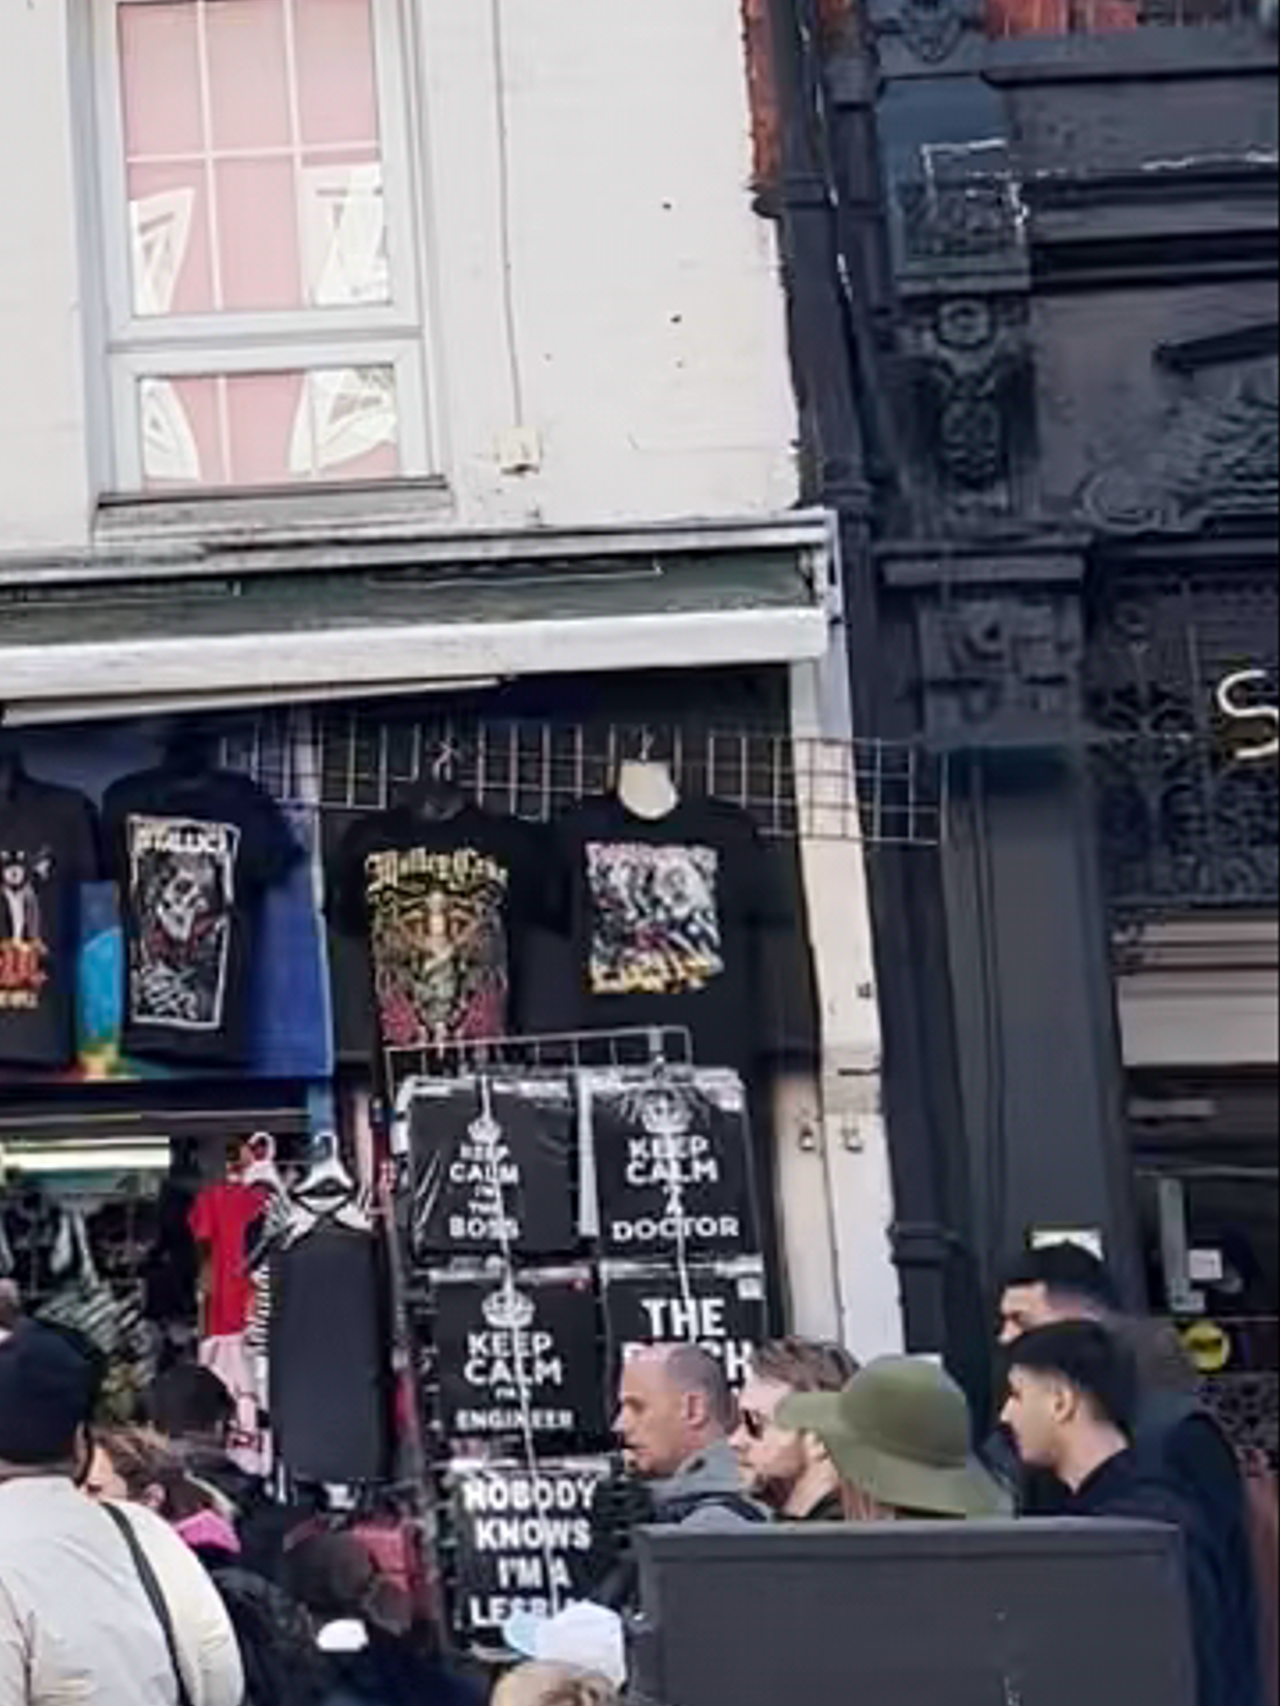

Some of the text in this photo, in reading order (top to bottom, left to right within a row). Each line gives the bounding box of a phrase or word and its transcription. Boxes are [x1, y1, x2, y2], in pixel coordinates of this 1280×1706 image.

[628, 1135, 710, 1160] KEEP
[449, 1162, 520, 1183] CALM
[626, 1158, 718, 1185] CALM
[449, 1217, 520, 1241] BOSS
[612, 1215, 739, 1242] DOCTOR
[640, 1298, 726, 1337] THE
[468, 1330, 553, 1358] KEEP
[464, 1356, 563, 1386] CALM
[456, 1407, 574, 1432] ENGINEER
[463, 1478, 596, 1513] NOBODY
[475, 1517, 591, 1553] KNOWS
[498, 1557, 573, 1589] I'M A
